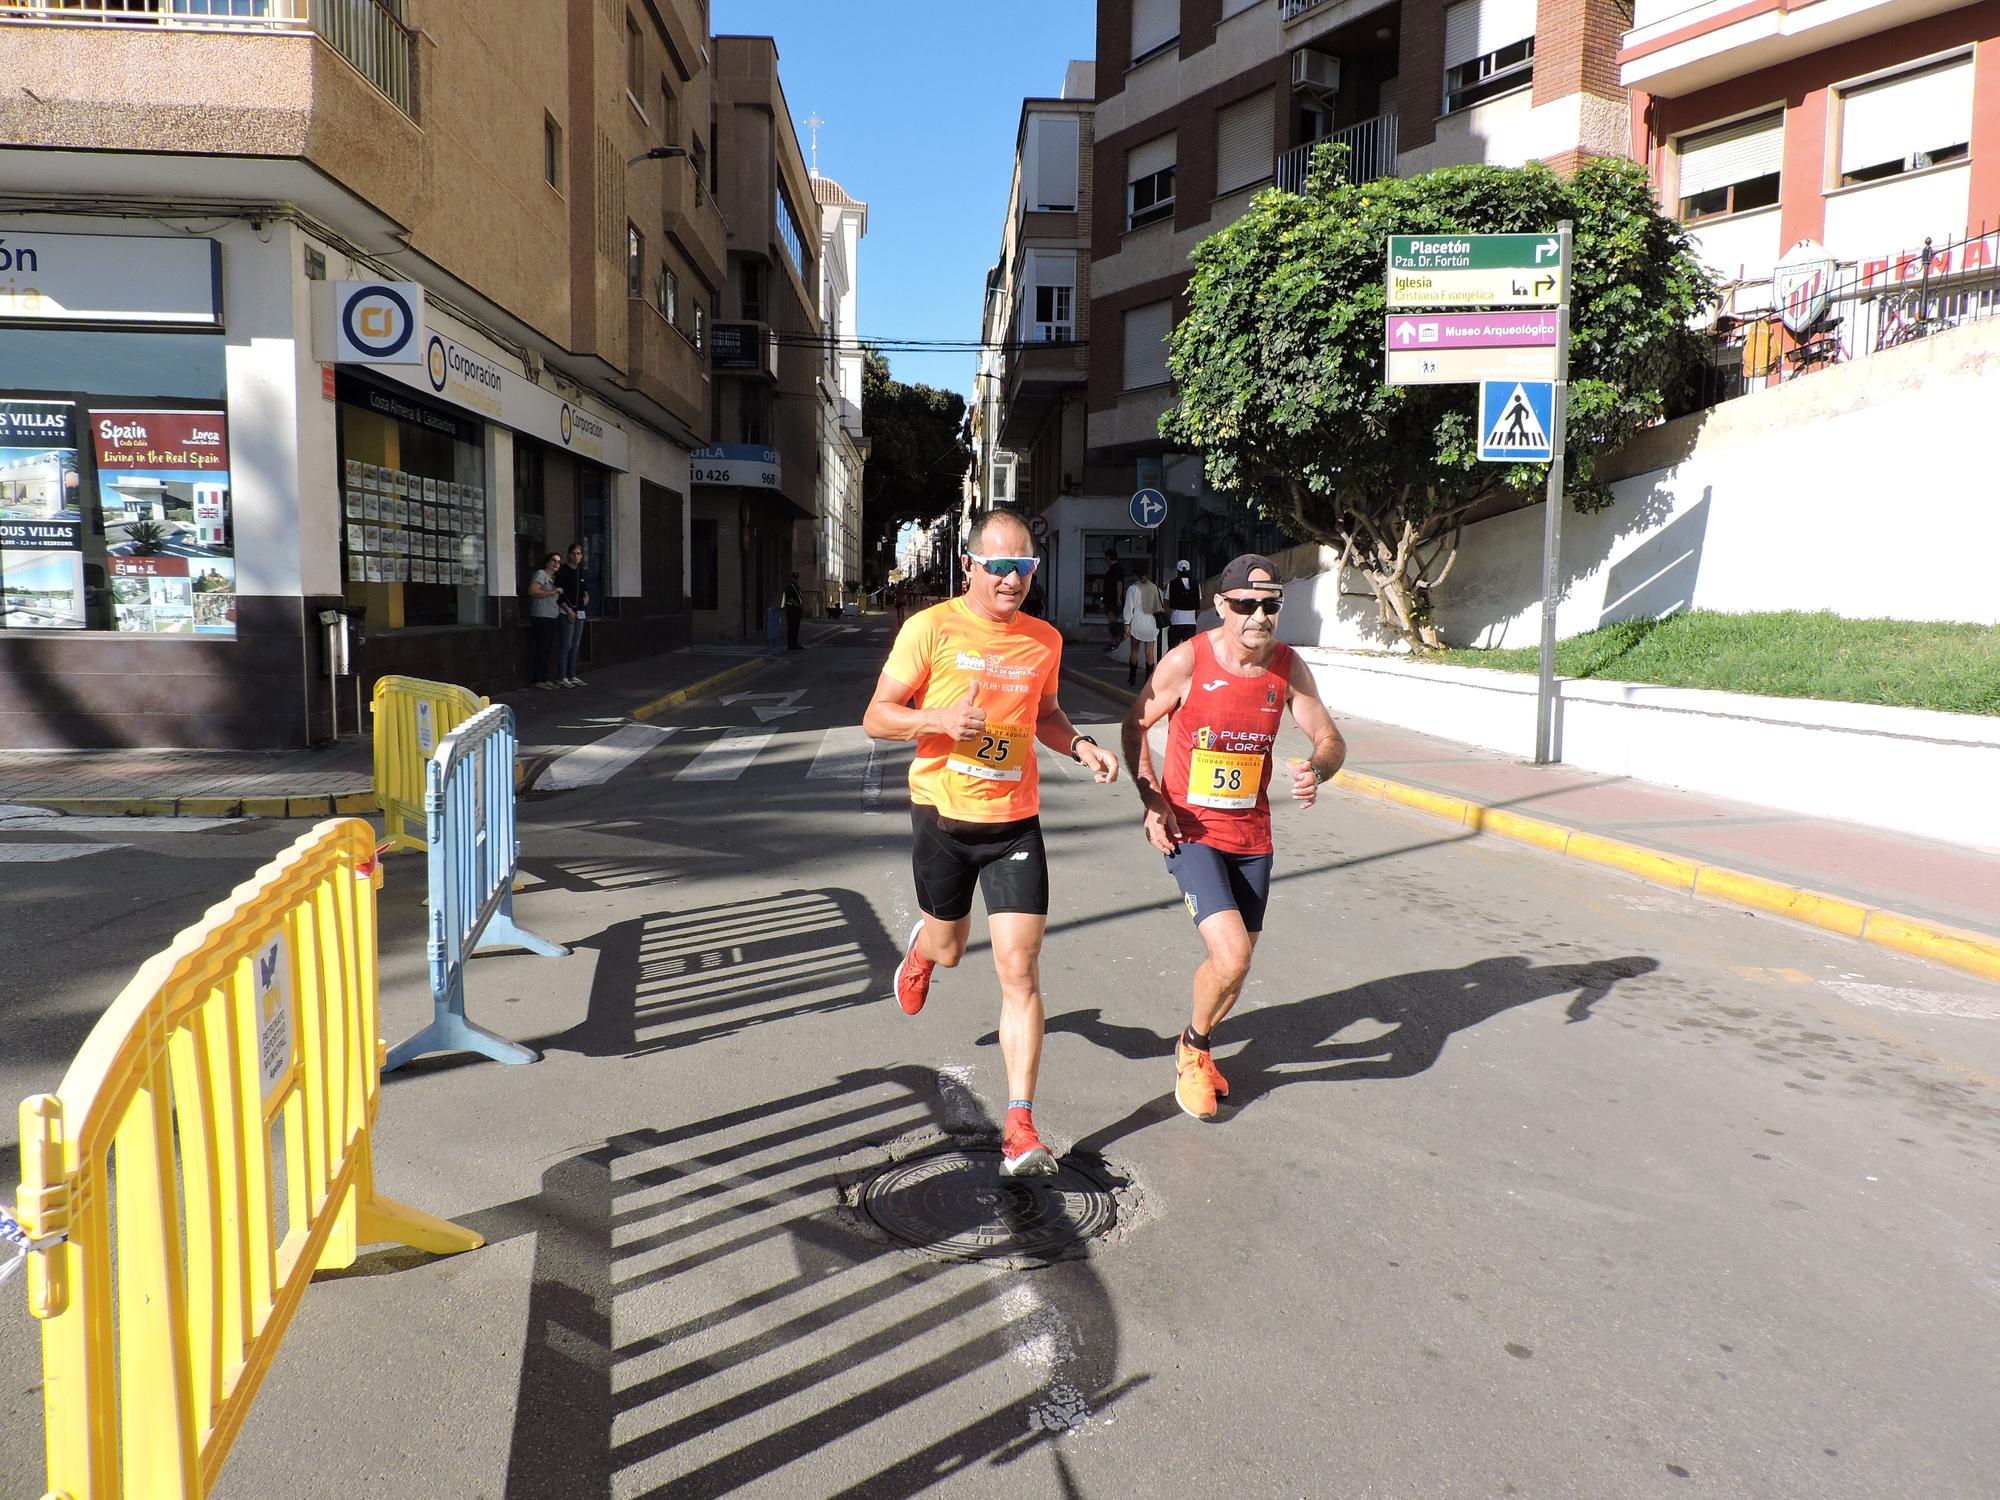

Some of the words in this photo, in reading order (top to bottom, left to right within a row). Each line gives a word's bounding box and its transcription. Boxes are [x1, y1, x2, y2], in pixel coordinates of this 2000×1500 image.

[1410, 240, 1471, 254] Placetón
[1395, 256, 1416, 267] Pza.
[1418, 256, 1433, 267] Dr.
[1435, 255, 1470, 267] Fortún
[1395, 276, 1432, 290] Iglesia
[1395, 290, 1439, 301] Cristiana
[1441, 289, 1494, 301] Evangélica
[1445, 326, 1481, 337] Museo
[1482, 324, 1555, 337] Arqueológico
[448, 345, 502, 392] Corporación
[10, 414, 66, 428] VILLAS
[100, 420, 147, 448] Spain
[192, 428, 220, 440] Lorca
[103, 451, 134, 468] Living
[136, 452, 146, 463] in
[147, 450, 164, 464] the
[165, 451, 186, 464] Real
[190, 452, 220, 468] Spain
[706, 470, 730, 481] 426
[28, 526, 73, 538] VILLAS
[976, 736, 1010, 762] 25
[1226, 742, 1270, 752] LORCA
[1197, 757, 1224, 765] CIUDAD
[1213, 768, 1241, 790] 58
